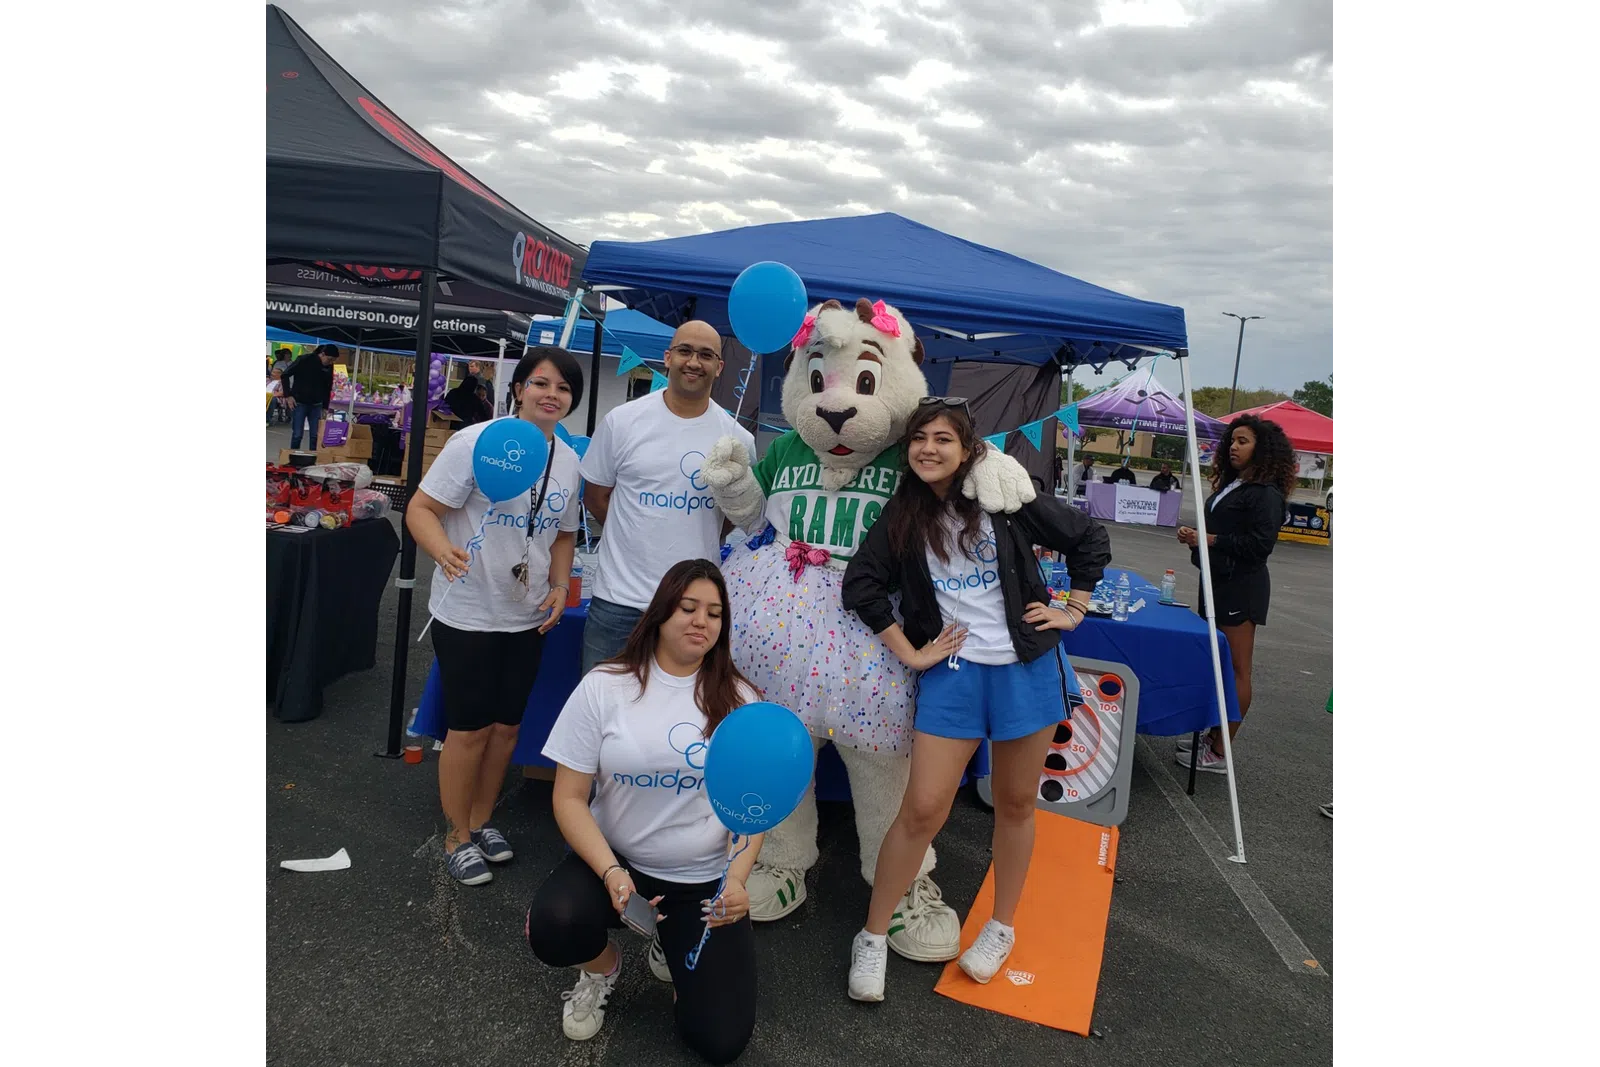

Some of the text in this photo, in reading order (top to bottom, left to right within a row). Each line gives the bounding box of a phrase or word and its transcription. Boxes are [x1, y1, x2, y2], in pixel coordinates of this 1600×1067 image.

[1159, 421, 1190, 432] FITNES
[480, 455, 522, 473] maidpro
[771, 463, 824, 491] AYD
[639, 490, 715, 515] maidpro
[932, 567, 999, 592] maidp
[1100, 703, 1118, 713] 100
[1072, 744, 1086, 753] 30
[613, 769, 704, 795] maidpr
[1066, 788, 1078, 798] 10
[713, 798, 768, 825] maidpro
